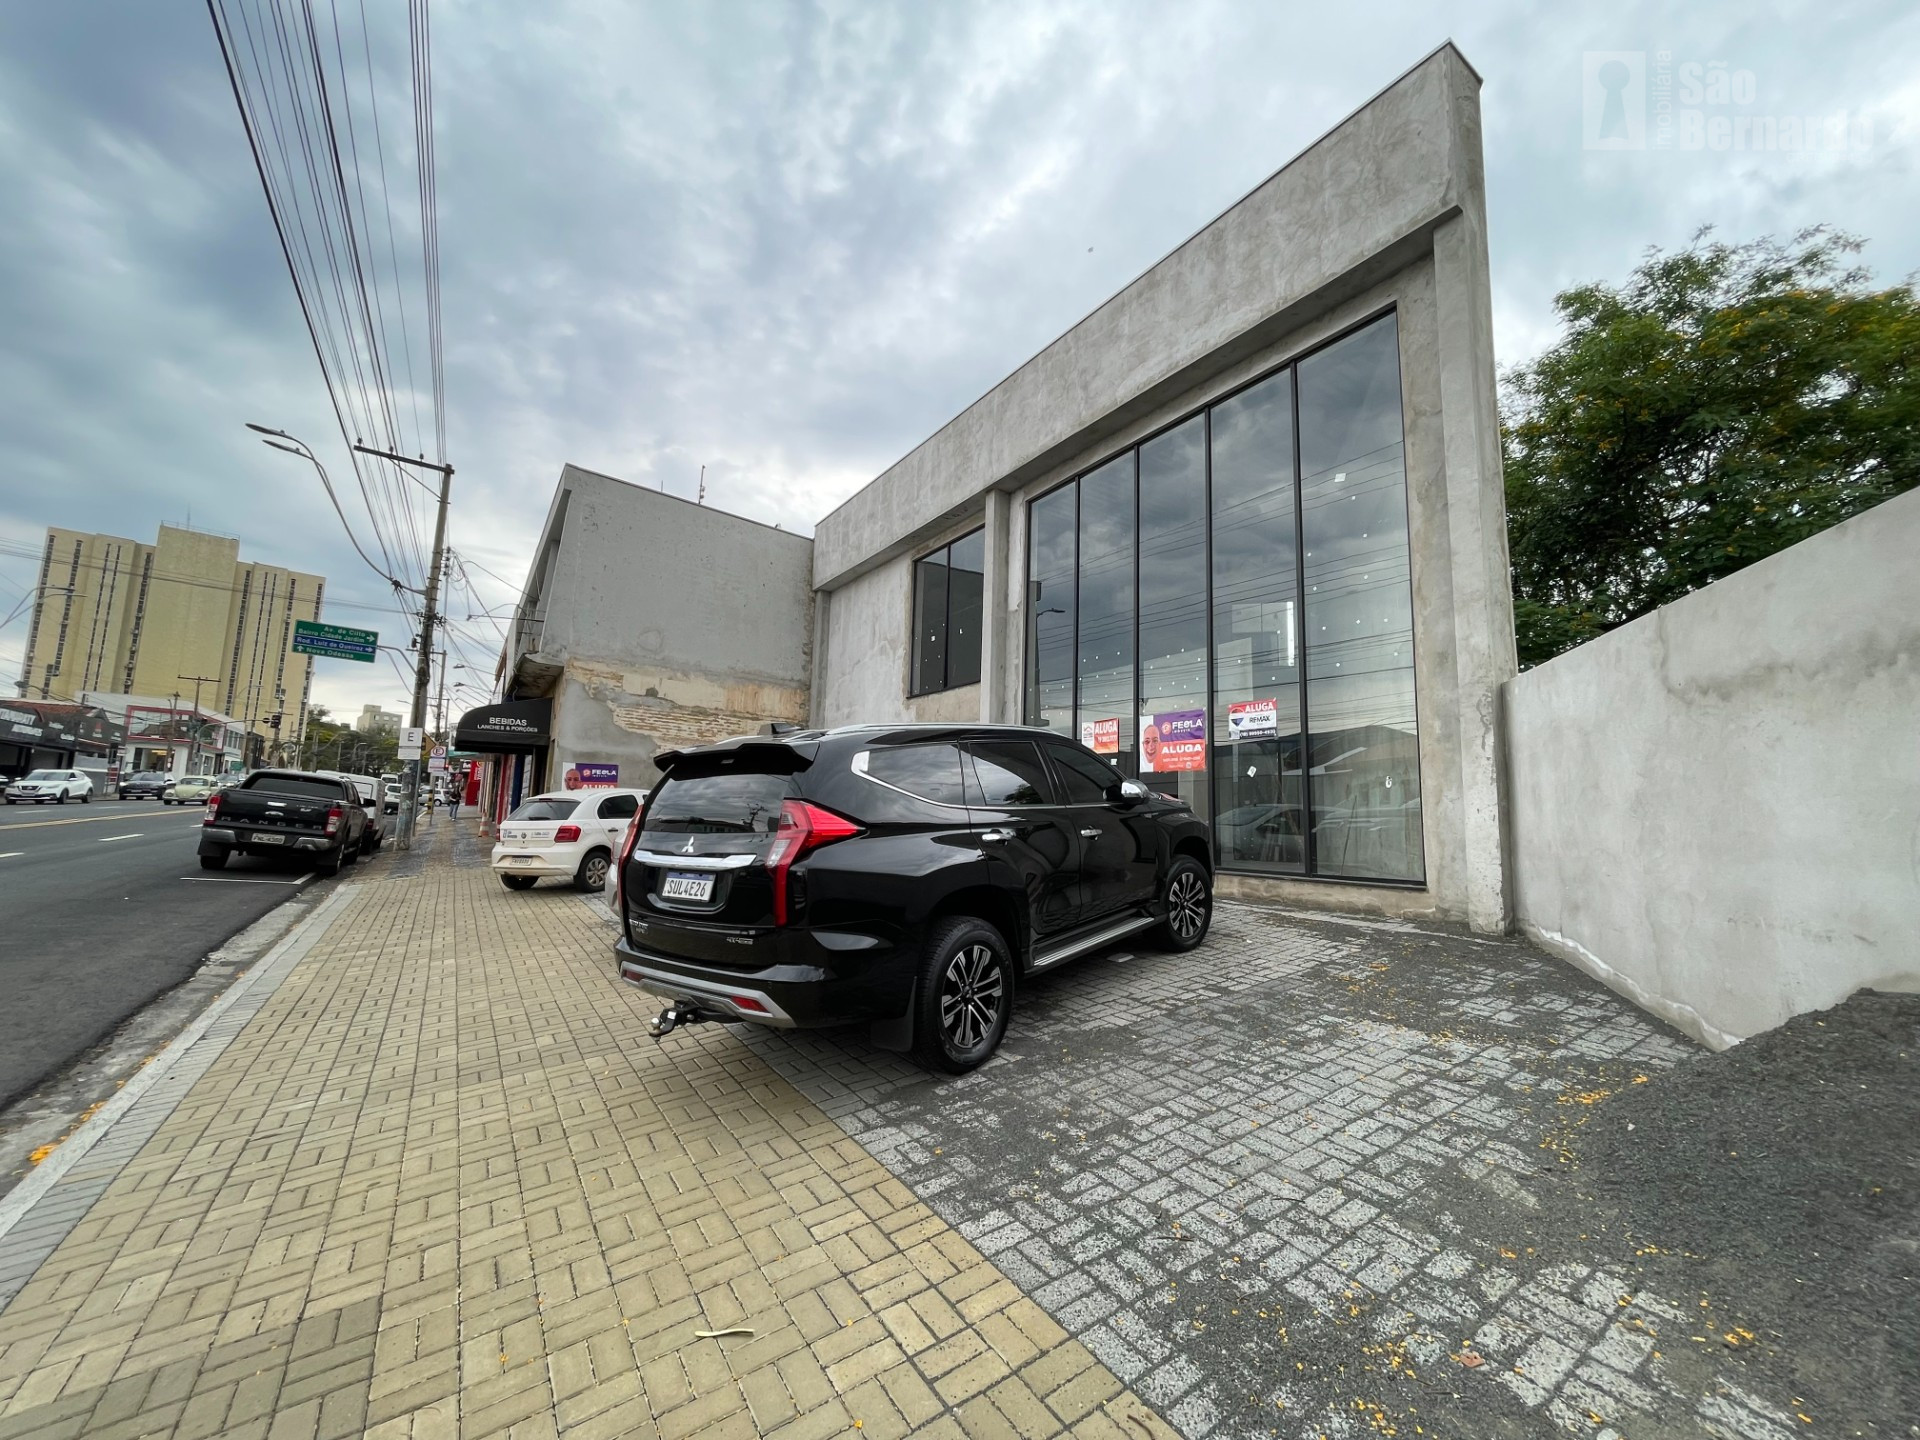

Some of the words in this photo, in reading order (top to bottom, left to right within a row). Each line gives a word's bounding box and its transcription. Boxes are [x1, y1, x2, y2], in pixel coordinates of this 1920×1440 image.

[298, 628, 319, 637] Bairro
[320, 631, 342, 640] Cidade
[343, 635, 365, 643] Jardim
[296, 636, 313, 644] Rod.
[313, 639, 328, 647] Luiz
[306, 647, 326, 655] Nova
[327, 649, 354, 659] Odessa
[1244, 702, 1274, 713] ALUGA
[489, 716, 527, 727] BEBIDAS
[1094, 720, 1118, 735] ALUGA
[408, 732, 414, 742] E
[1161, 743, 1203, 754] ALUGA
[667, 879, 707, 898] SUL4E26
